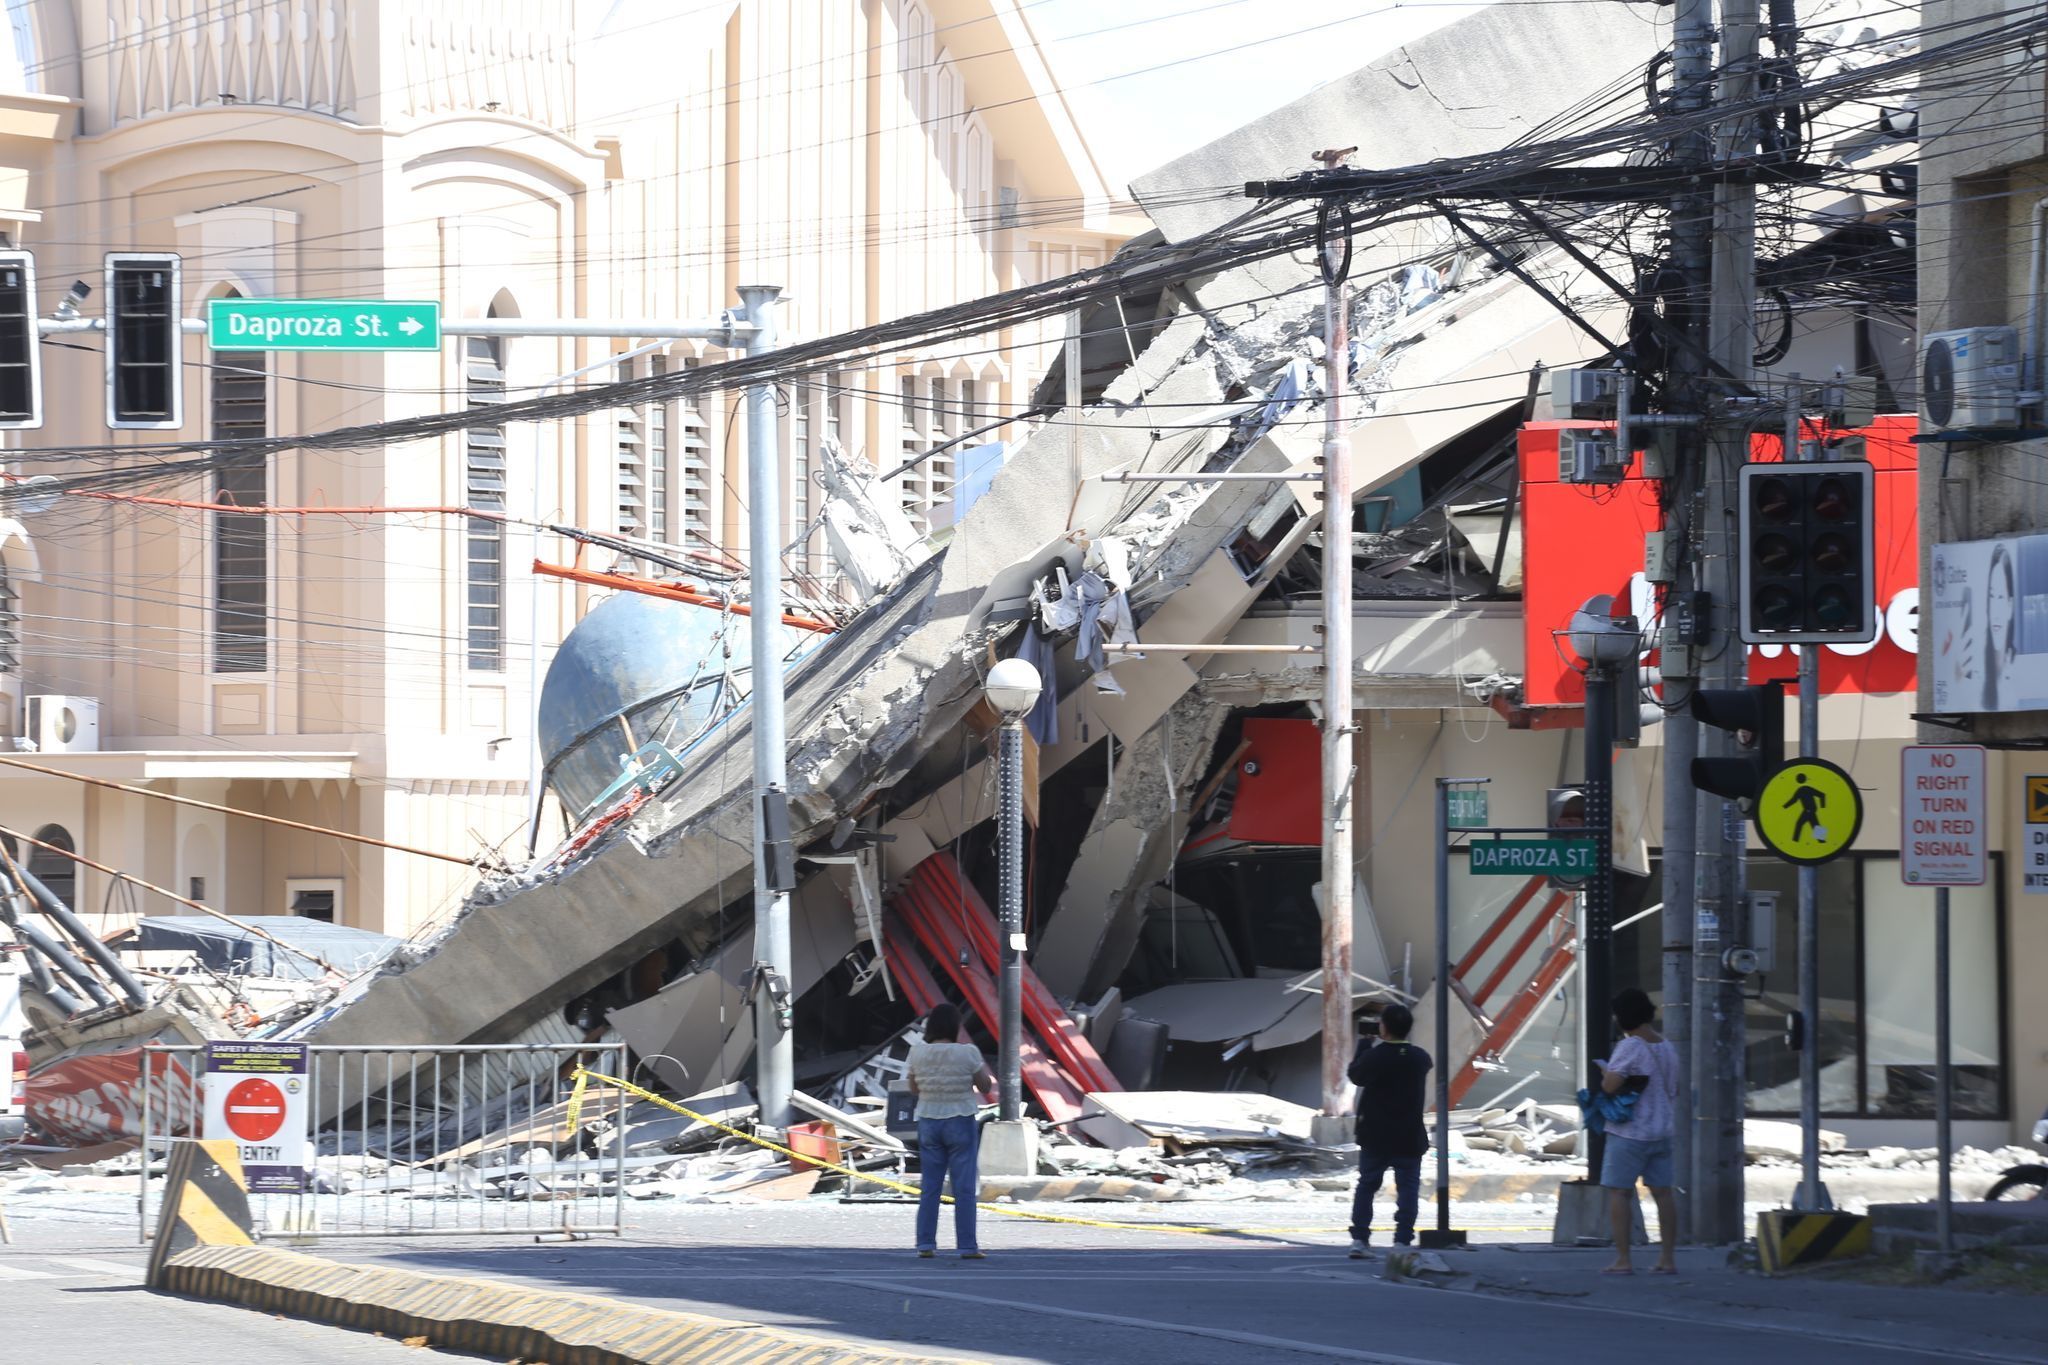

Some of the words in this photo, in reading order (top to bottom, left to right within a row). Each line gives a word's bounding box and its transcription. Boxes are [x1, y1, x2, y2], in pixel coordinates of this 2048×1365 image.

[229, 313, 342, 342] Daproza
[354, 314, 390, 337] St.
[1930, 753, 1956, 768] NO
[1916, 775, 1970, 791] RIGHT
[1920, 797, 1968, 813] TURN
[1912, 819, 1937, 835] ON
[1941, 819, 1975, 835] RED
[1913, 841, 1975, 857] SIGNAL
[1472, 847, 1560, 867] DAPROZA
[1566, 848, 1594, 868] ST.
[244, 1145, 282, 1161] ENTRY
